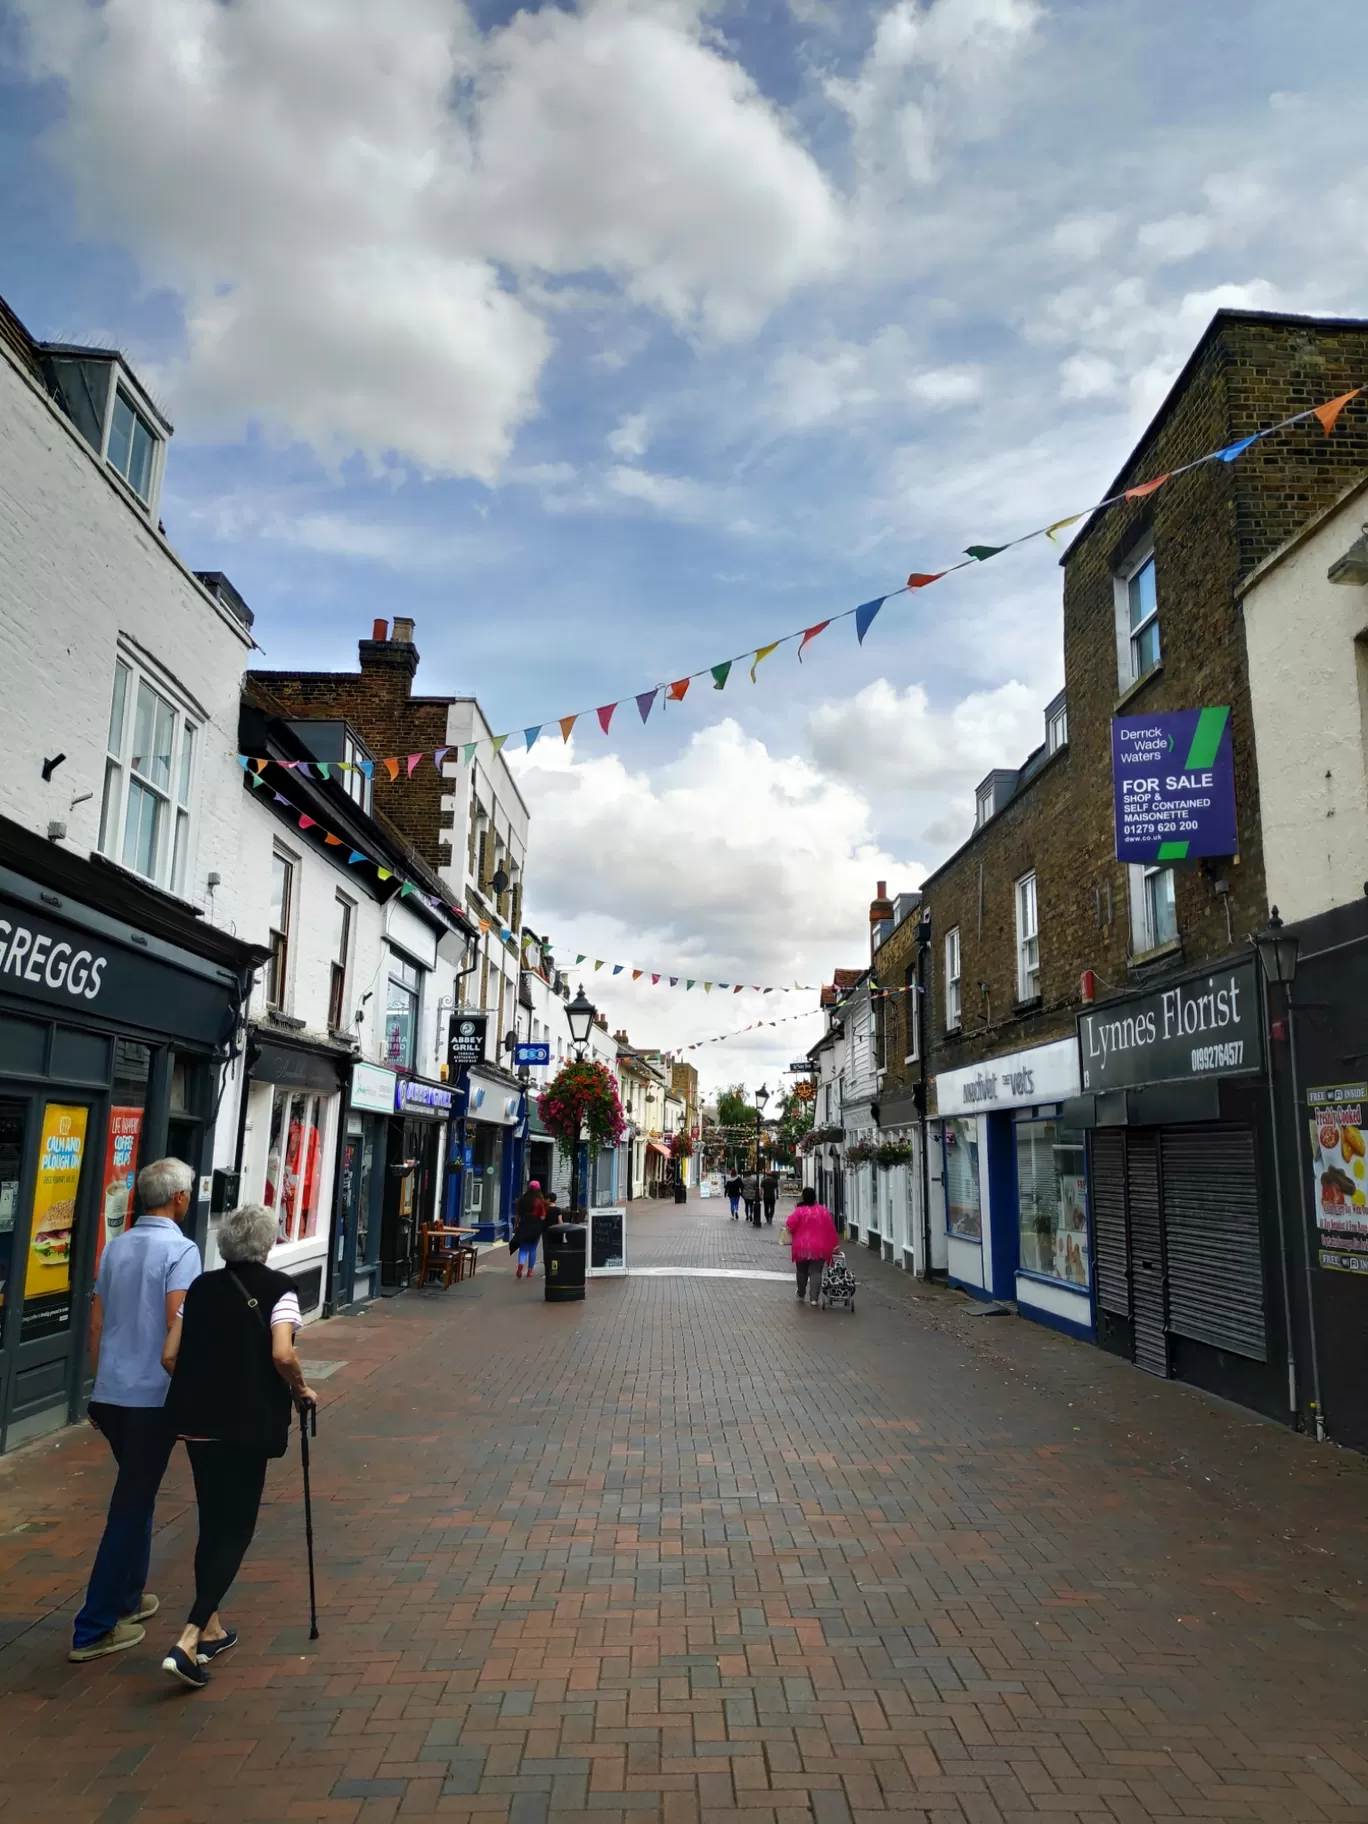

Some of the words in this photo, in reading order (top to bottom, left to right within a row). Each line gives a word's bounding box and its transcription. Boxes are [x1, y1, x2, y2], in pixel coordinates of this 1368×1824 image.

[1121, 727, 1162, 742] Derrick
[1134, 739, 1167, 751] Wade
[1121, 751, 1161, 763] Waters
[1123, 778, 1159, 793] FOR
[1166, 774, 1213, 790] SALE
[1124, 794, 1151, 803] SHOP
[1154, 793, 1161, 801] &
[1124, 803, 1149, 813] SELF
[1152, 798, 1210, 811] CONTAINED
[1124, 810, 1189, 822] MAISONETTE
[1124, 823, 1155, 835] 01279
[1157, 822, 1176, 832] 620
[1179, 820, 1198, 830] 200
[1125, 834, 1162, 842] dww.co.uk
[1087, 1011, 1156, 1070] Lynnes
[1161, 976, 1240, 1040] Florist
[451, 1036, 483, 1044] ABBEY
[1191, 1040, 1244, 1072] 01992764577
[1010, 1065, 1035, 1096] vets
[1344, 1088, 1366, 1098] INSIDE
[112, 1151, 132, 1168] HELPS
[1323, 1254, 1341, 1266] FREE
